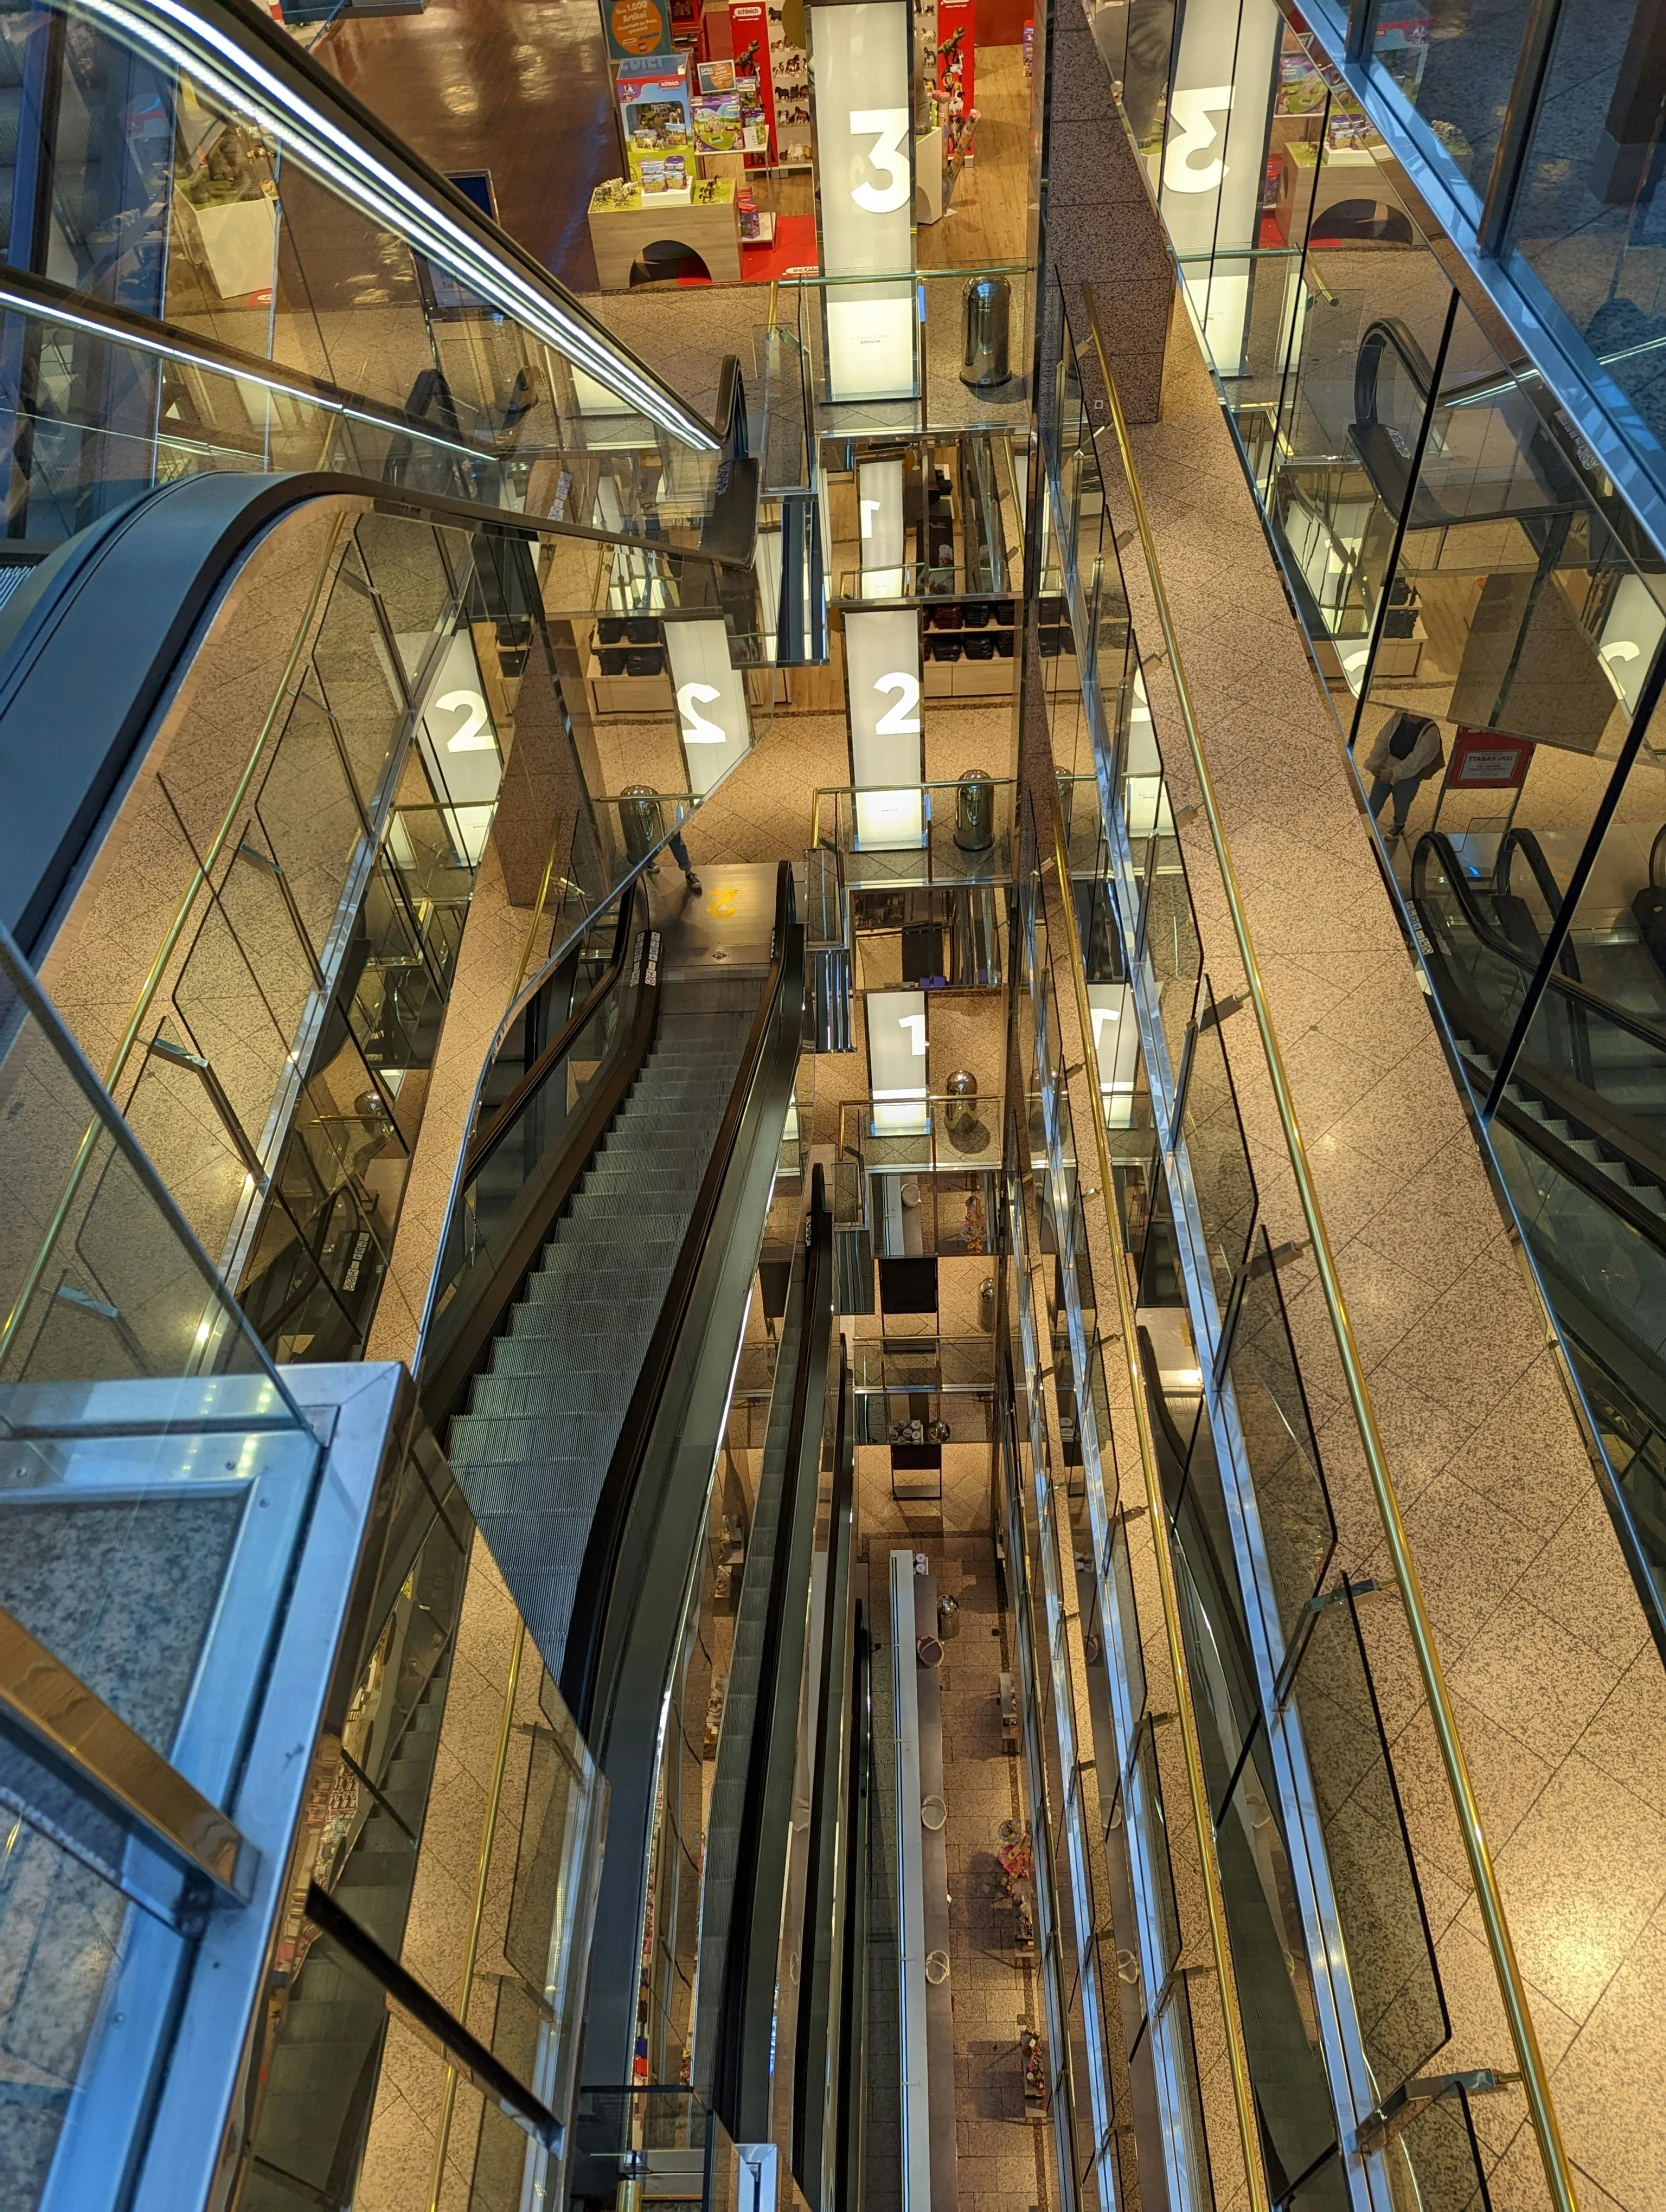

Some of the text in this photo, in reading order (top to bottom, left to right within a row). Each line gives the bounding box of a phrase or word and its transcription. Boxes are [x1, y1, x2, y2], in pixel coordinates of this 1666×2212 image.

[623, 10, 647, 22] Artikel
[626, 1, 648, 12] 1.000
[849, 107, 911, 214] 3
[435, 689, 500, 753] 2
[873, 671, 921, 736] 2
[897, 1014, 926, 1056] 1
